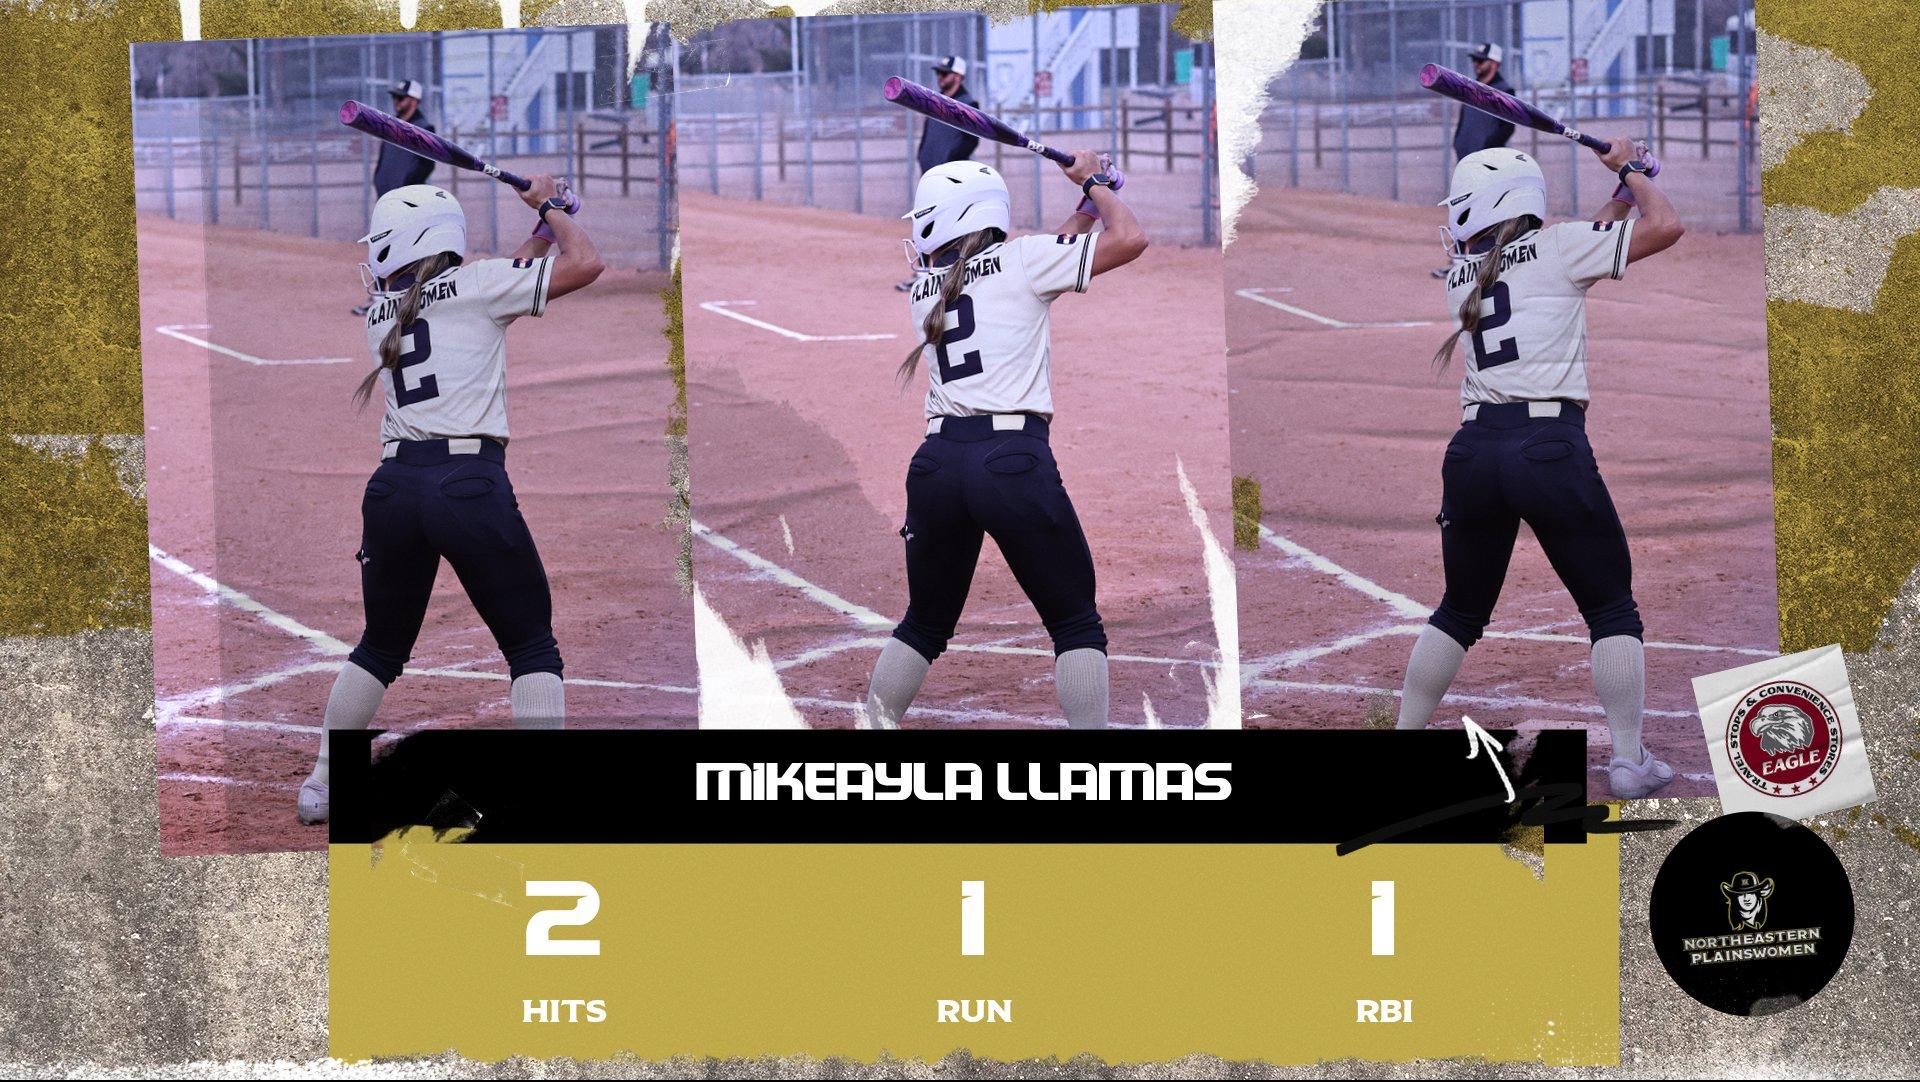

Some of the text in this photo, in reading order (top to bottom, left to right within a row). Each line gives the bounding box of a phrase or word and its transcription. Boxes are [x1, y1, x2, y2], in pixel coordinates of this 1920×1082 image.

[391, 317, 440, 409] 2
[937, 294, 984, 385] 2
[1472, 281, 1520, 372] 2
